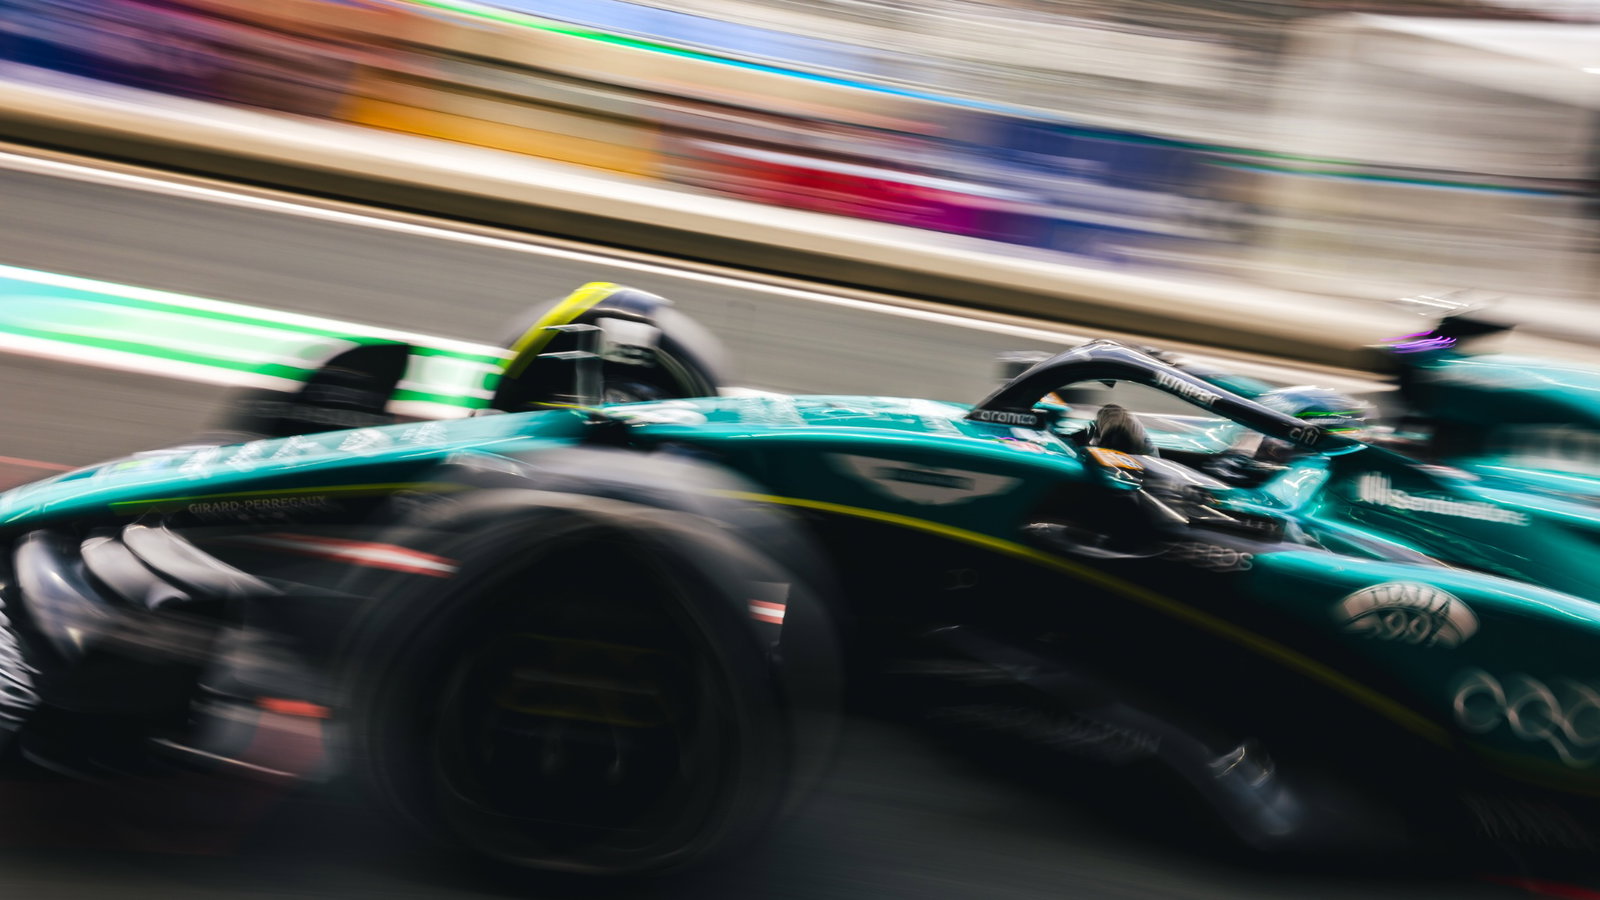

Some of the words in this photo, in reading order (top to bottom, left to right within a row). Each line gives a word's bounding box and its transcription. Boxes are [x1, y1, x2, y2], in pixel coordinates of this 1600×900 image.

[981, 410, 1038, 425] aramco
[1289, 425, 1321, 447] citi
[188, 496, 327, 514] GIRARD-PERREGAUX
